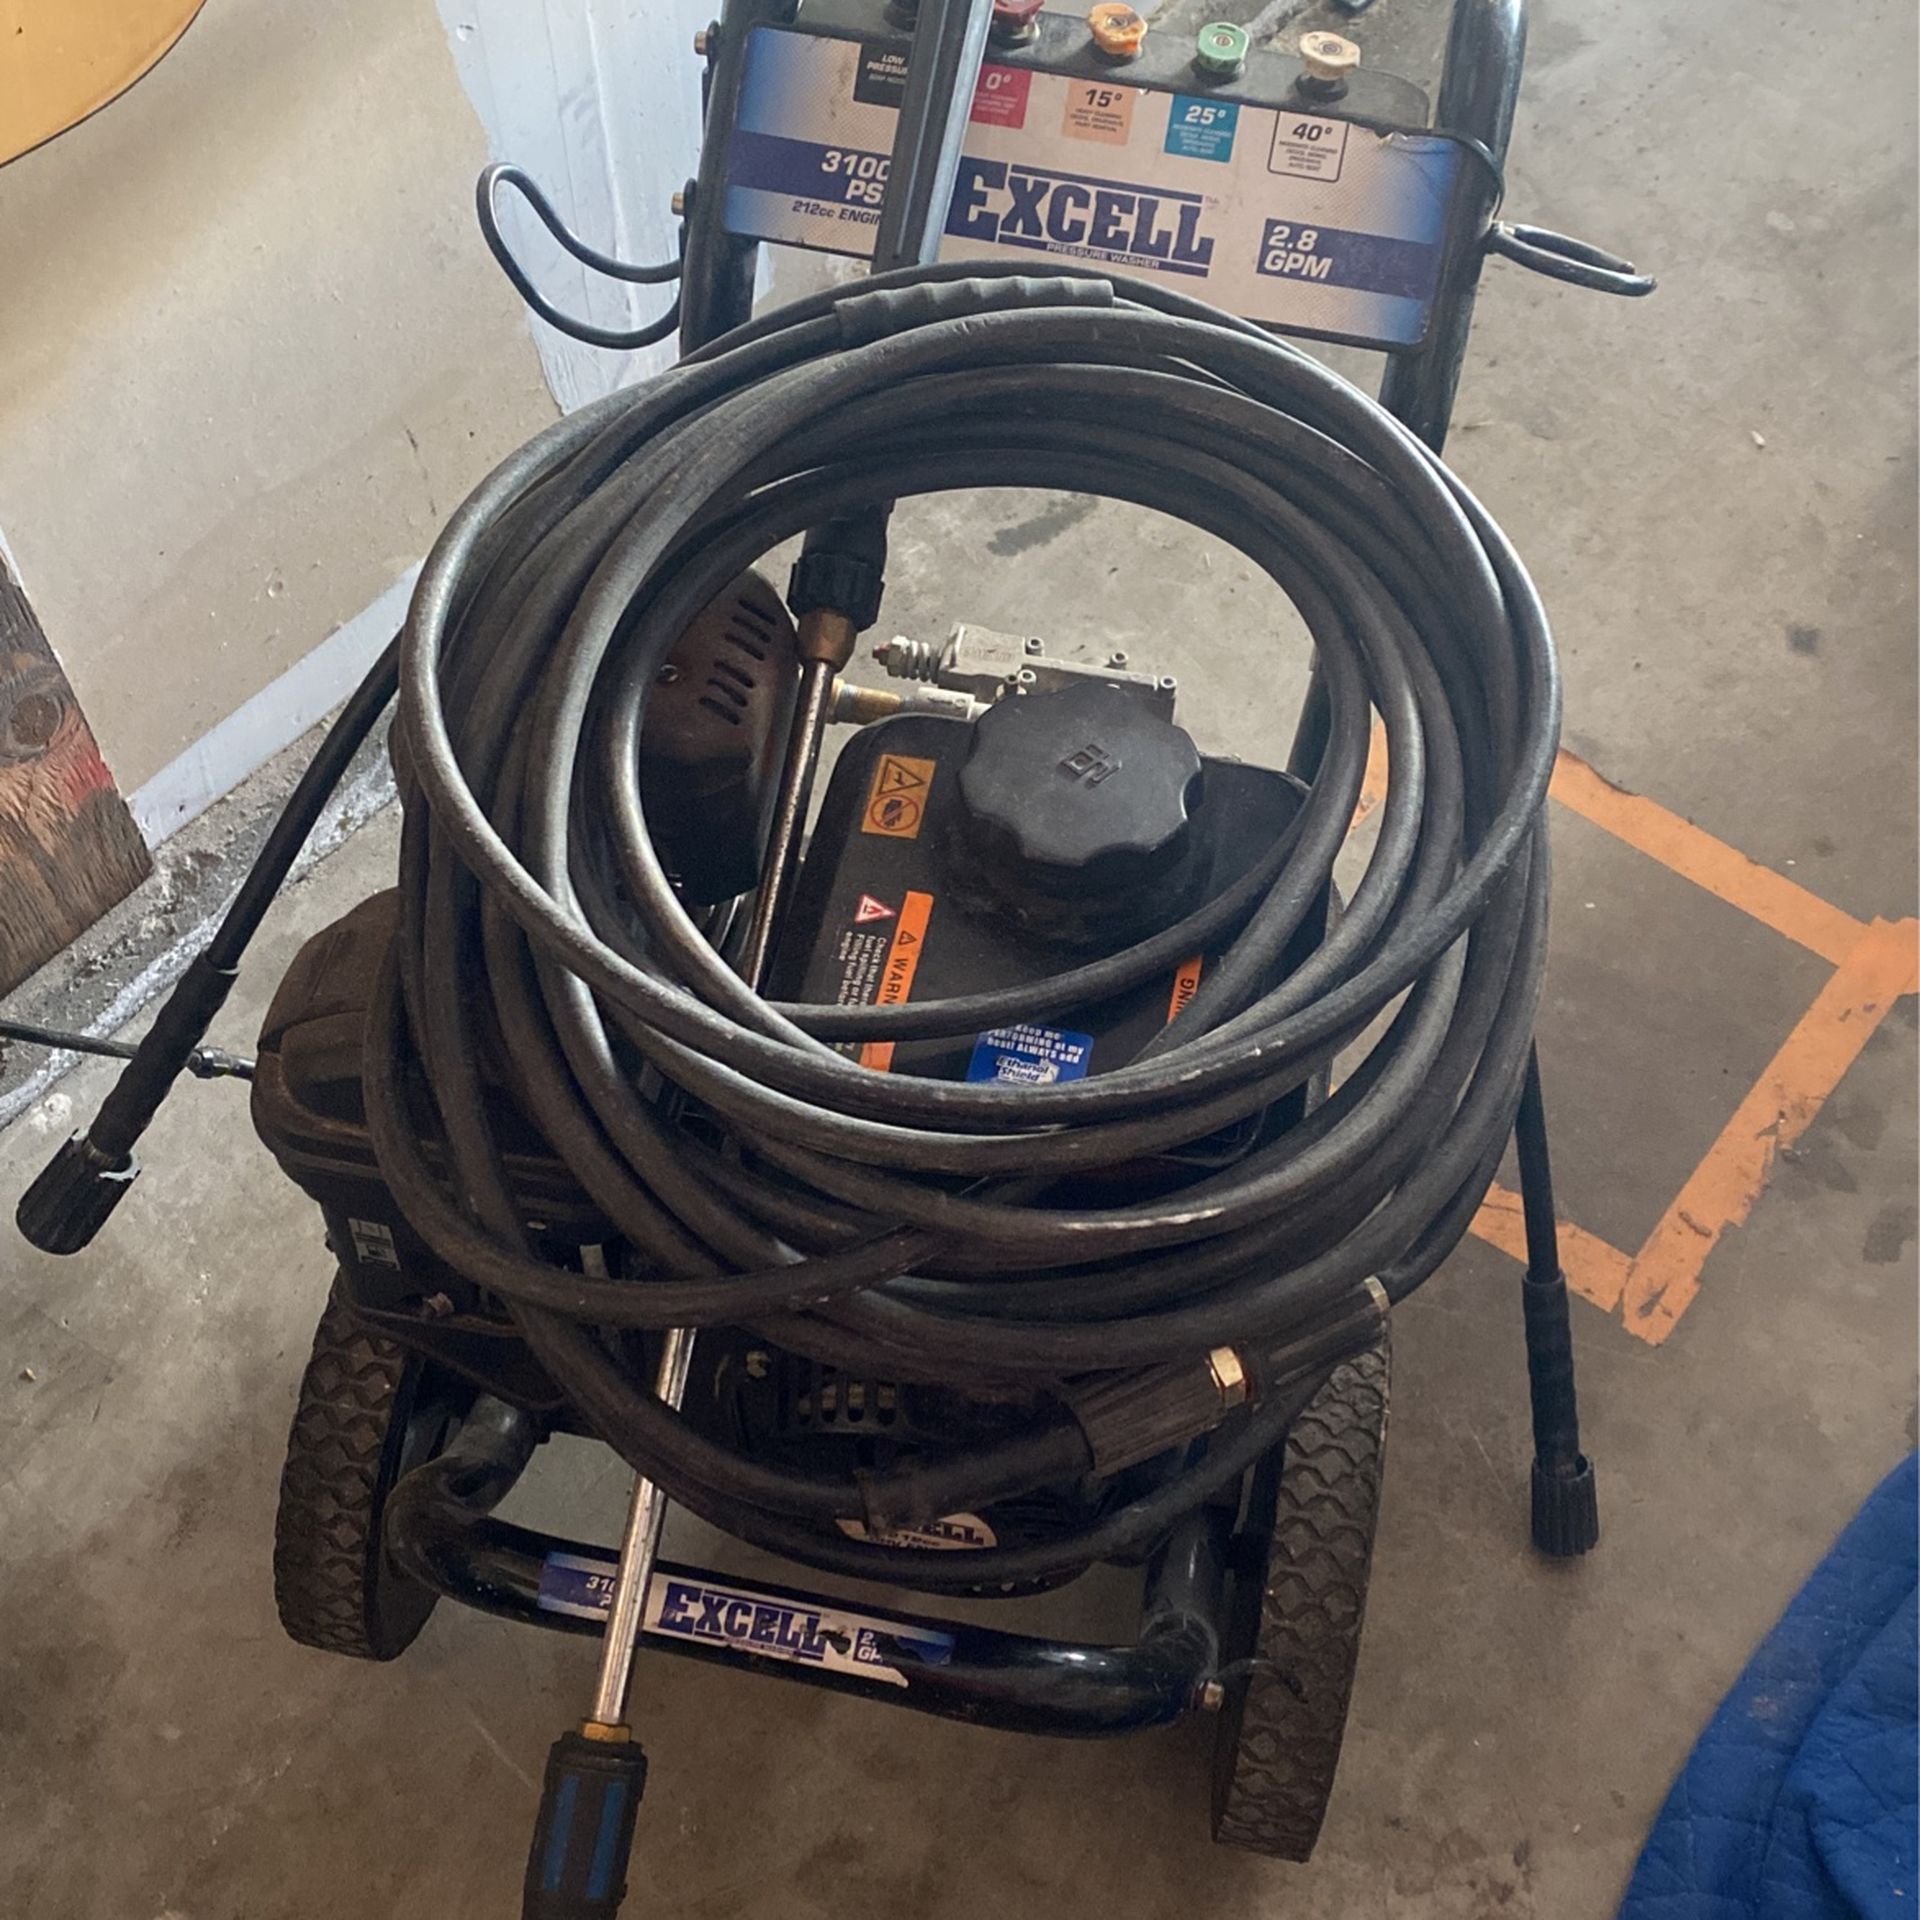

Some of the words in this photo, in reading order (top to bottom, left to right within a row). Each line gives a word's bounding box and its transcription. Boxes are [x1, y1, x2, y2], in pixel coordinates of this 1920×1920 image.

[866, 61, 909, 75] PRESSUR
[1085, 88, 1123, 108] 15°
[1184, 105, 1227, 125] 25°
[1292, 122, 1333, 142] 40°
[845, 178, 884, 206] PS
[792, 200, 836, 219] 212cc
[944, 155, 1215, 266] EXCELL
[1268, 225, 1318, 252] 2.8
[1046, 242, 1107, 261] PRESSURE
[1110, 253, 1160, 269] WASHER
[1264, 249, 1333, 279] GPM
[883, 958, 908, 1004] WARN
[1016, 1043, 1057, 1060] ALWAYS
[1068, 1045, 1085, 1056] my
[585, 1575, 616, 1593] 31
[658, 1582, 827, 1653] EXCELL
[860, 1631, 876, 1647] 2.
